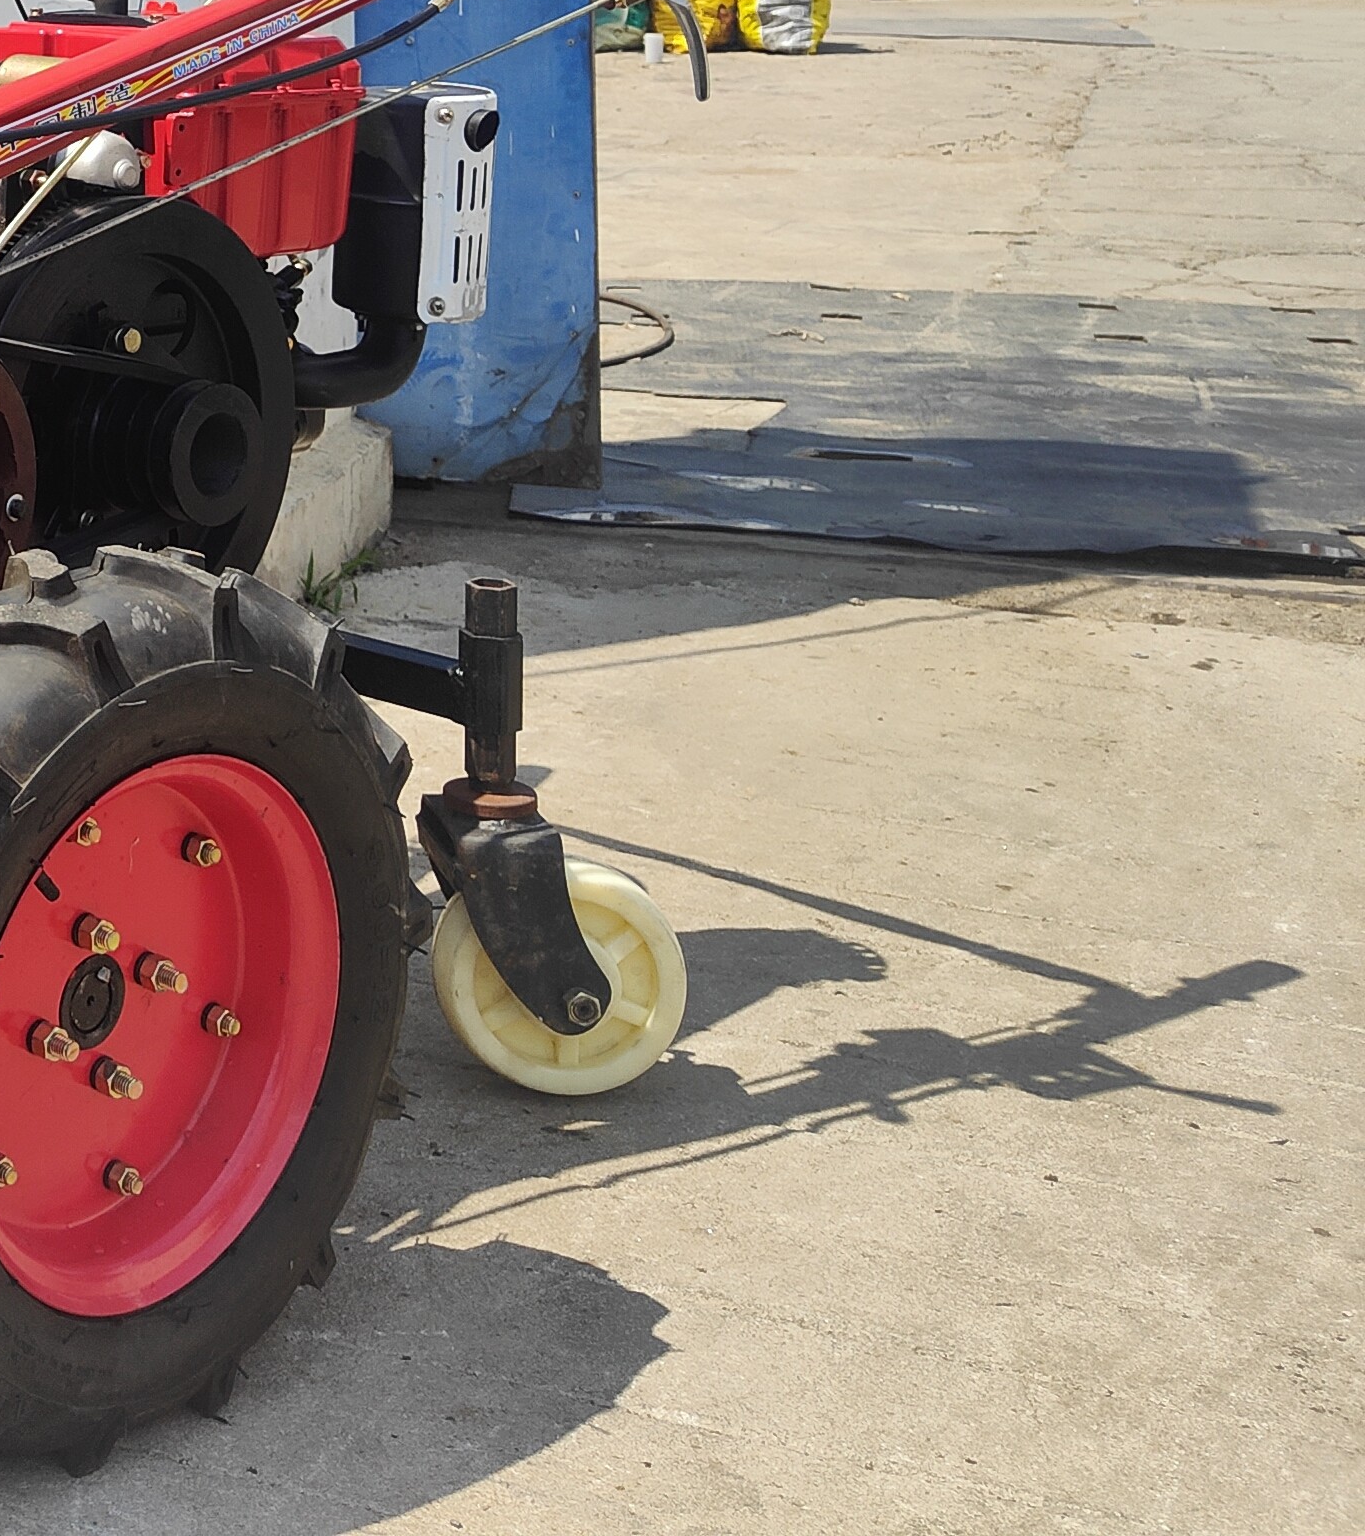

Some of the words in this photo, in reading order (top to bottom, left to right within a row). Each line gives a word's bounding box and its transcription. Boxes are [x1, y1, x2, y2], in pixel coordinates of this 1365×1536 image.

[172, 46, 221, 80] MADE
[225, 35, 244, 56] IN
[249, 11, 301, 44] CHINA
